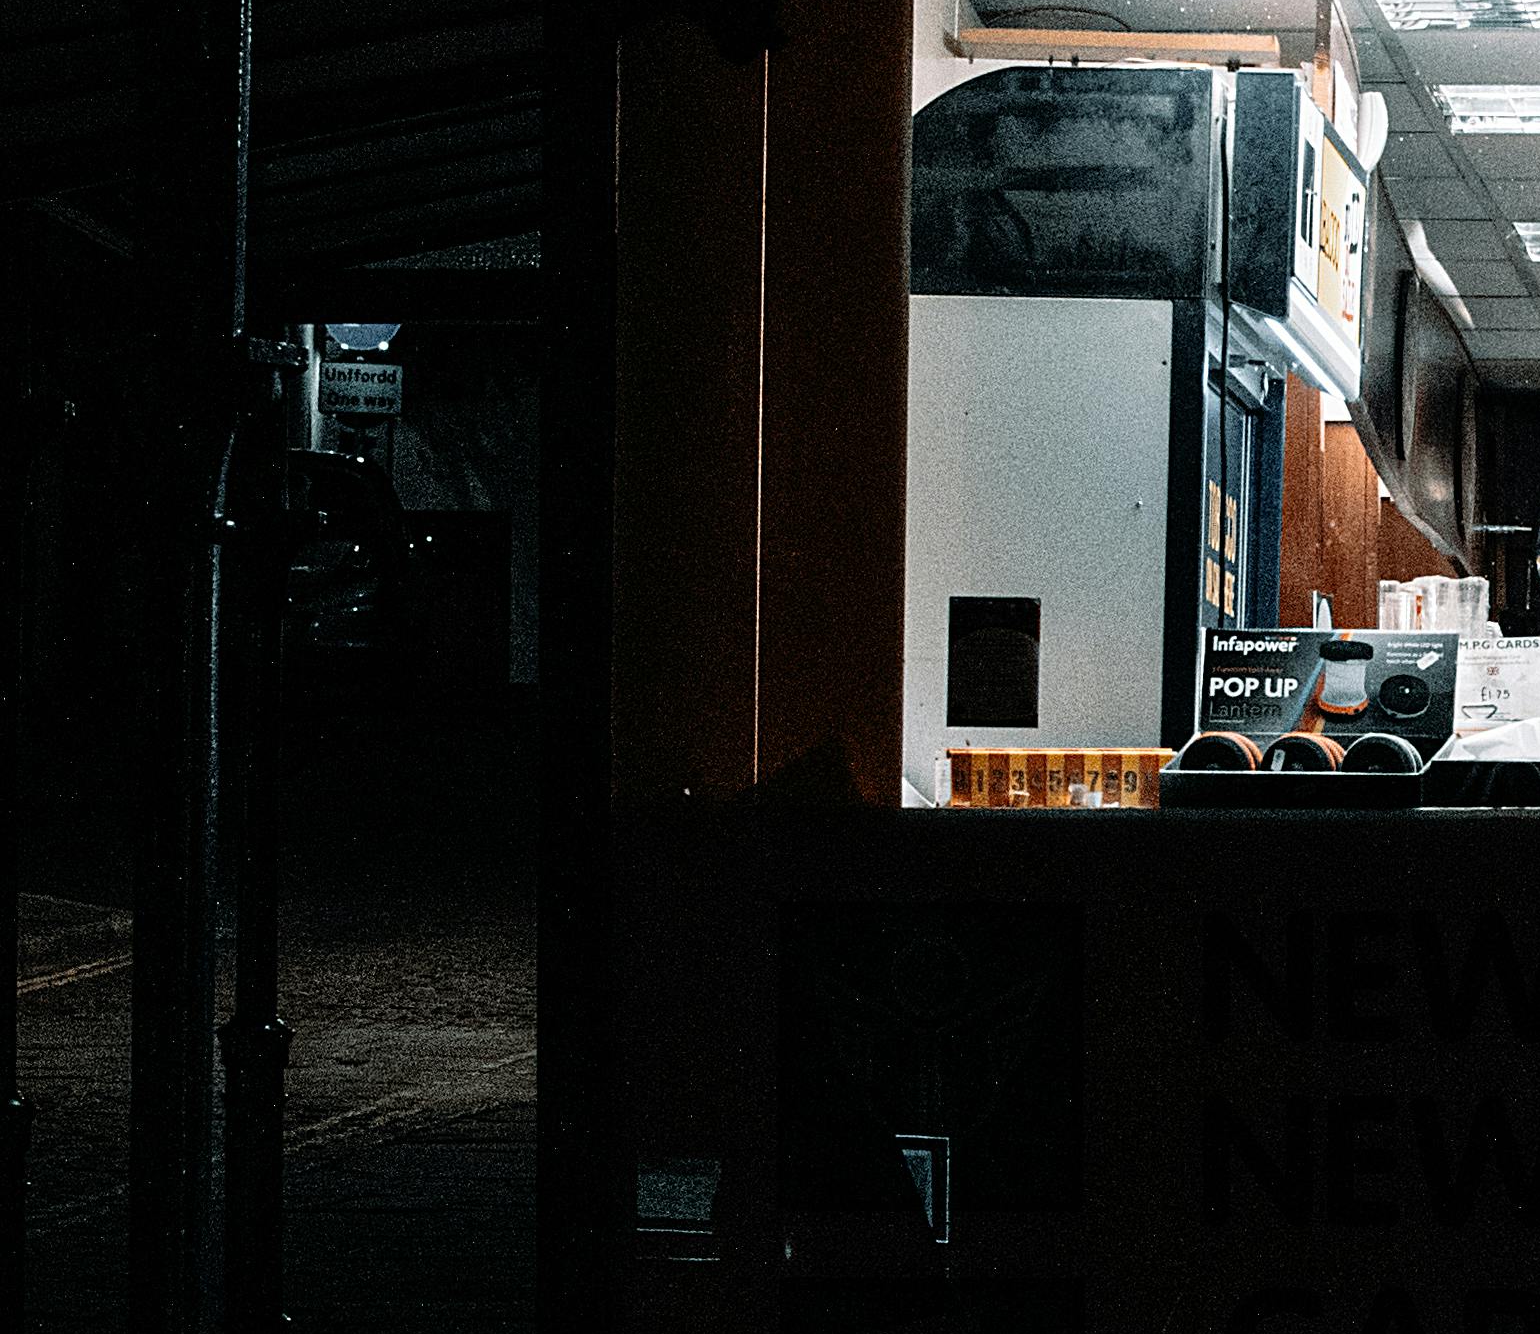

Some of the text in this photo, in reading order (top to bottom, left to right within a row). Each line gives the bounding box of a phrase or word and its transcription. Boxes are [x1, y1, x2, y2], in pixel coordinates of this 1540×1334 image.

[324, 367, 397, 386] Unifordd
[326, 390, 395, 410] One way
[1212, 634, 1299, 656] Infapower
[1496, 638, 1540, 650] CARDS
[1208, 676, 1299, 698] POP UP
[1209, 700, 1282, 719] Lantern
[1012, 769, 1026, 792] 3
[1086, 770, 1101, 792] 7
[1124, 770, 1138, 793] 9
